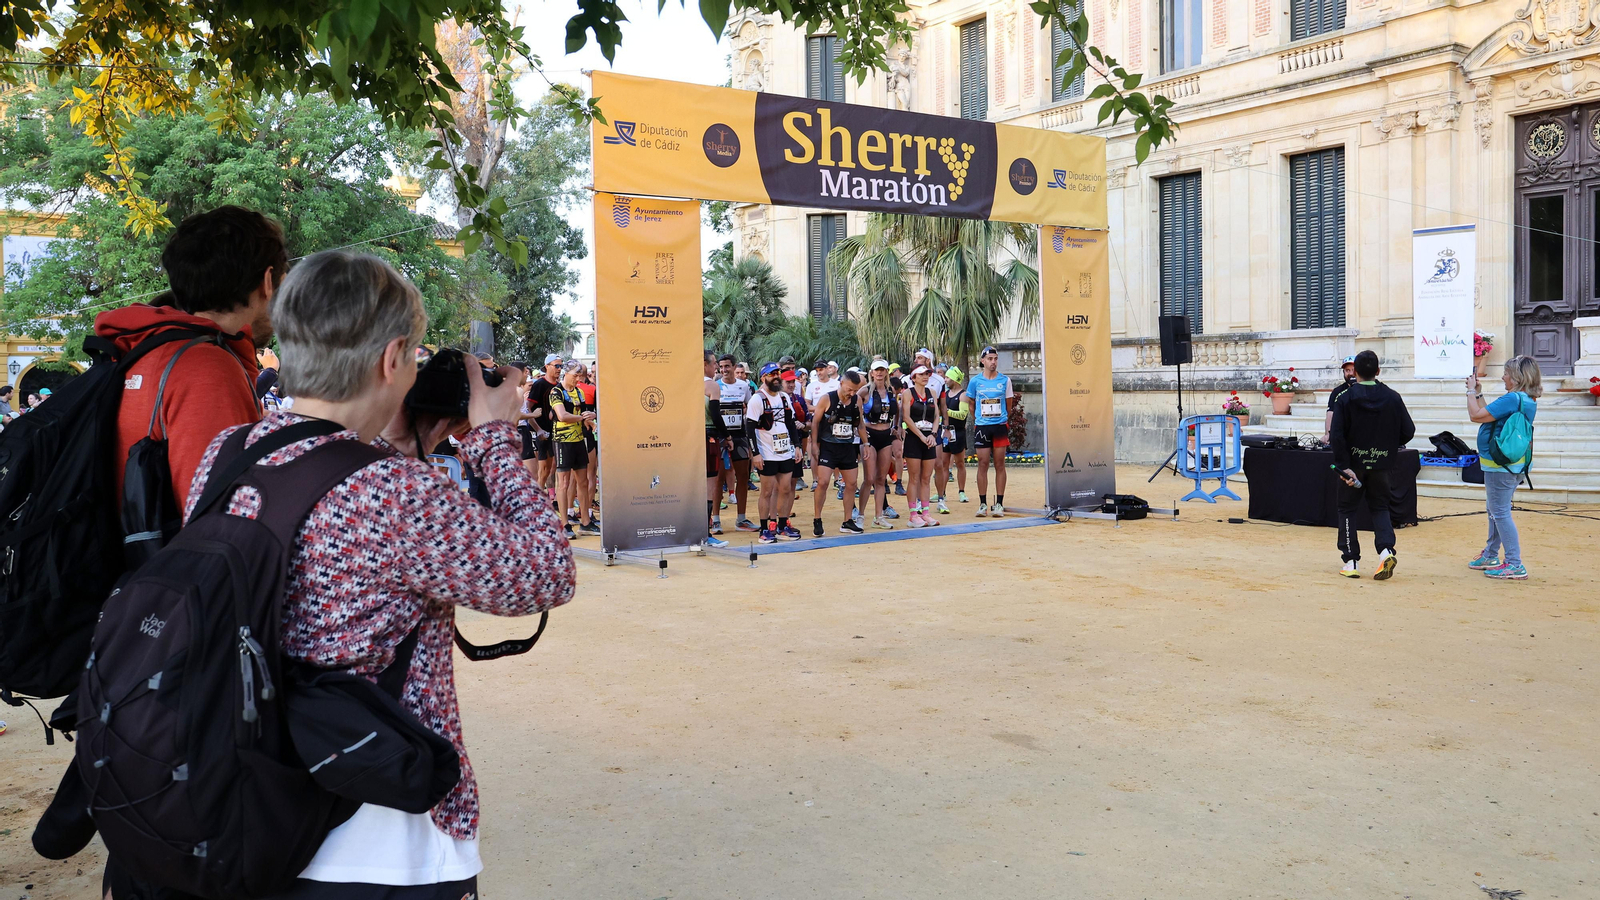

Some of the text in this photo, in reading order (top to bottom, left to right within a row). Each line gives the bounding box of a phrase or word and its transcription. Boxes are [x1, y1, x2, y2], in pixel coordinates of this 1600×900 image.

[640, 122, 689, 138] Diputación
[640, 138, 680, 151] de Cádiz
[706, 141, 737, 155] Sherry
[782, 108, 975, 201] Sherry
[1011, 173, 1035, 184] Sherry
[1068, 171, 1102, 182] Diputación
[820, 169, 948, 206] Maratón
[1068, 183, 1096, 192] de Cádiz
[634, 207, 684, 216] Ayuntamiento
[634, 306, 668, 318] HSN
[1067, 315, 1089, 324] HSN
[1420, 334, 1467, 347] Andalucía
[1351, 446, 1368, 457] Pepe
[144, 612, 166, 629] Jac
